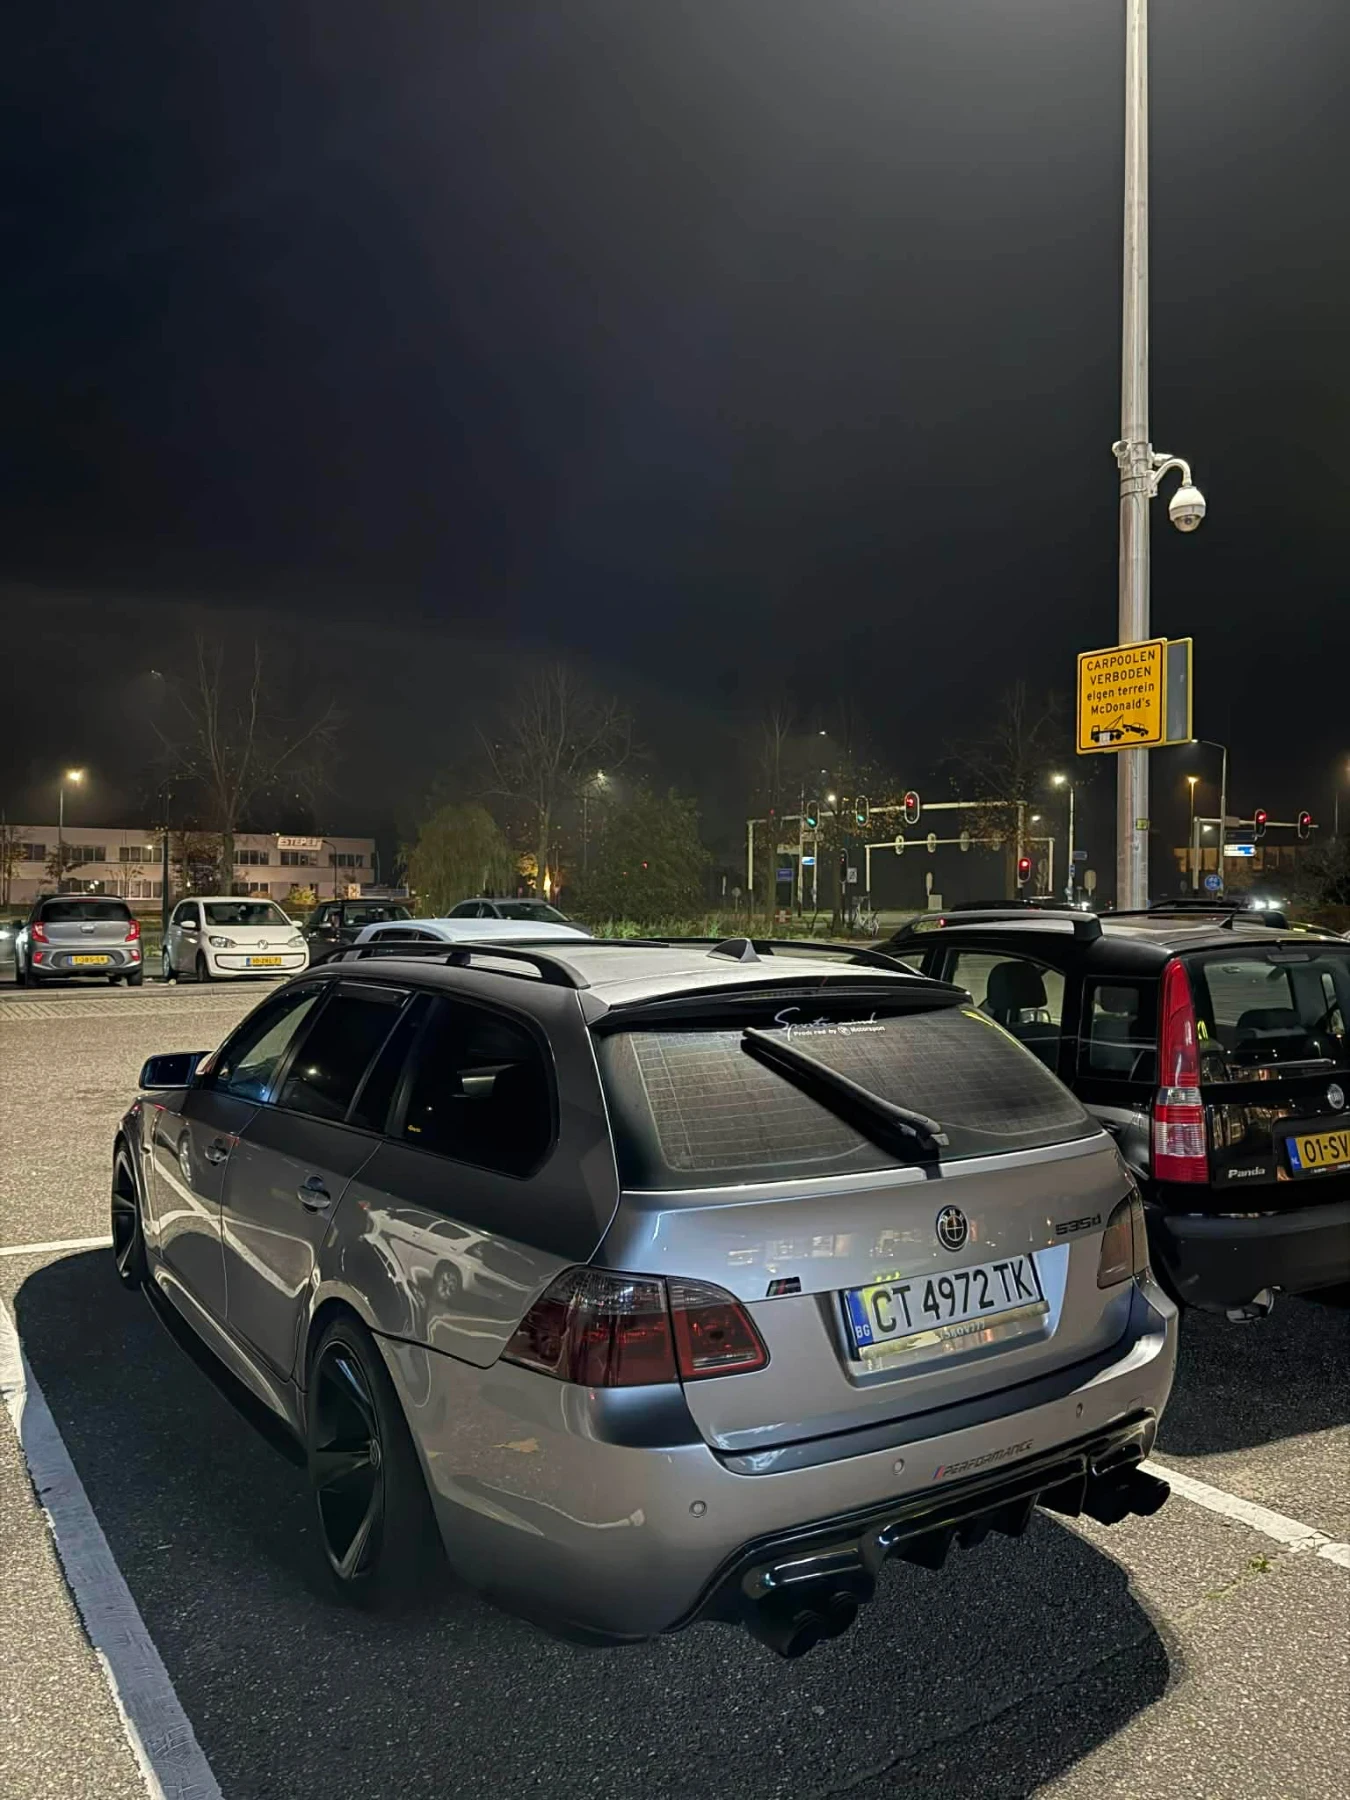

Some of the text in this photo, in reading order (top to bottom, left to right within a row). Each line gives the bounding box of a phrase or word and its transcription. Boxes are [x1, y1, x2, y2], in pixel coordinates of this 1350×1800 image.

[1087, 650, 1155, 671] CARPOOLEN
[1090, 666, 1151, 686] VERBODEN
[1087, 682, 1154, 701] eigen terrein
[1091, 698, 1151, 715] McDonald's
[1228, 1167, 1266, 1179] Panda
[1055, 1213, 1102, 1235] 535d
[871, 1260, 1033, 1333] CT 4972 TK
[855, 1324, 871, 1339] BG
[943, 1439, 1034, 1477] PERFORMANCE
